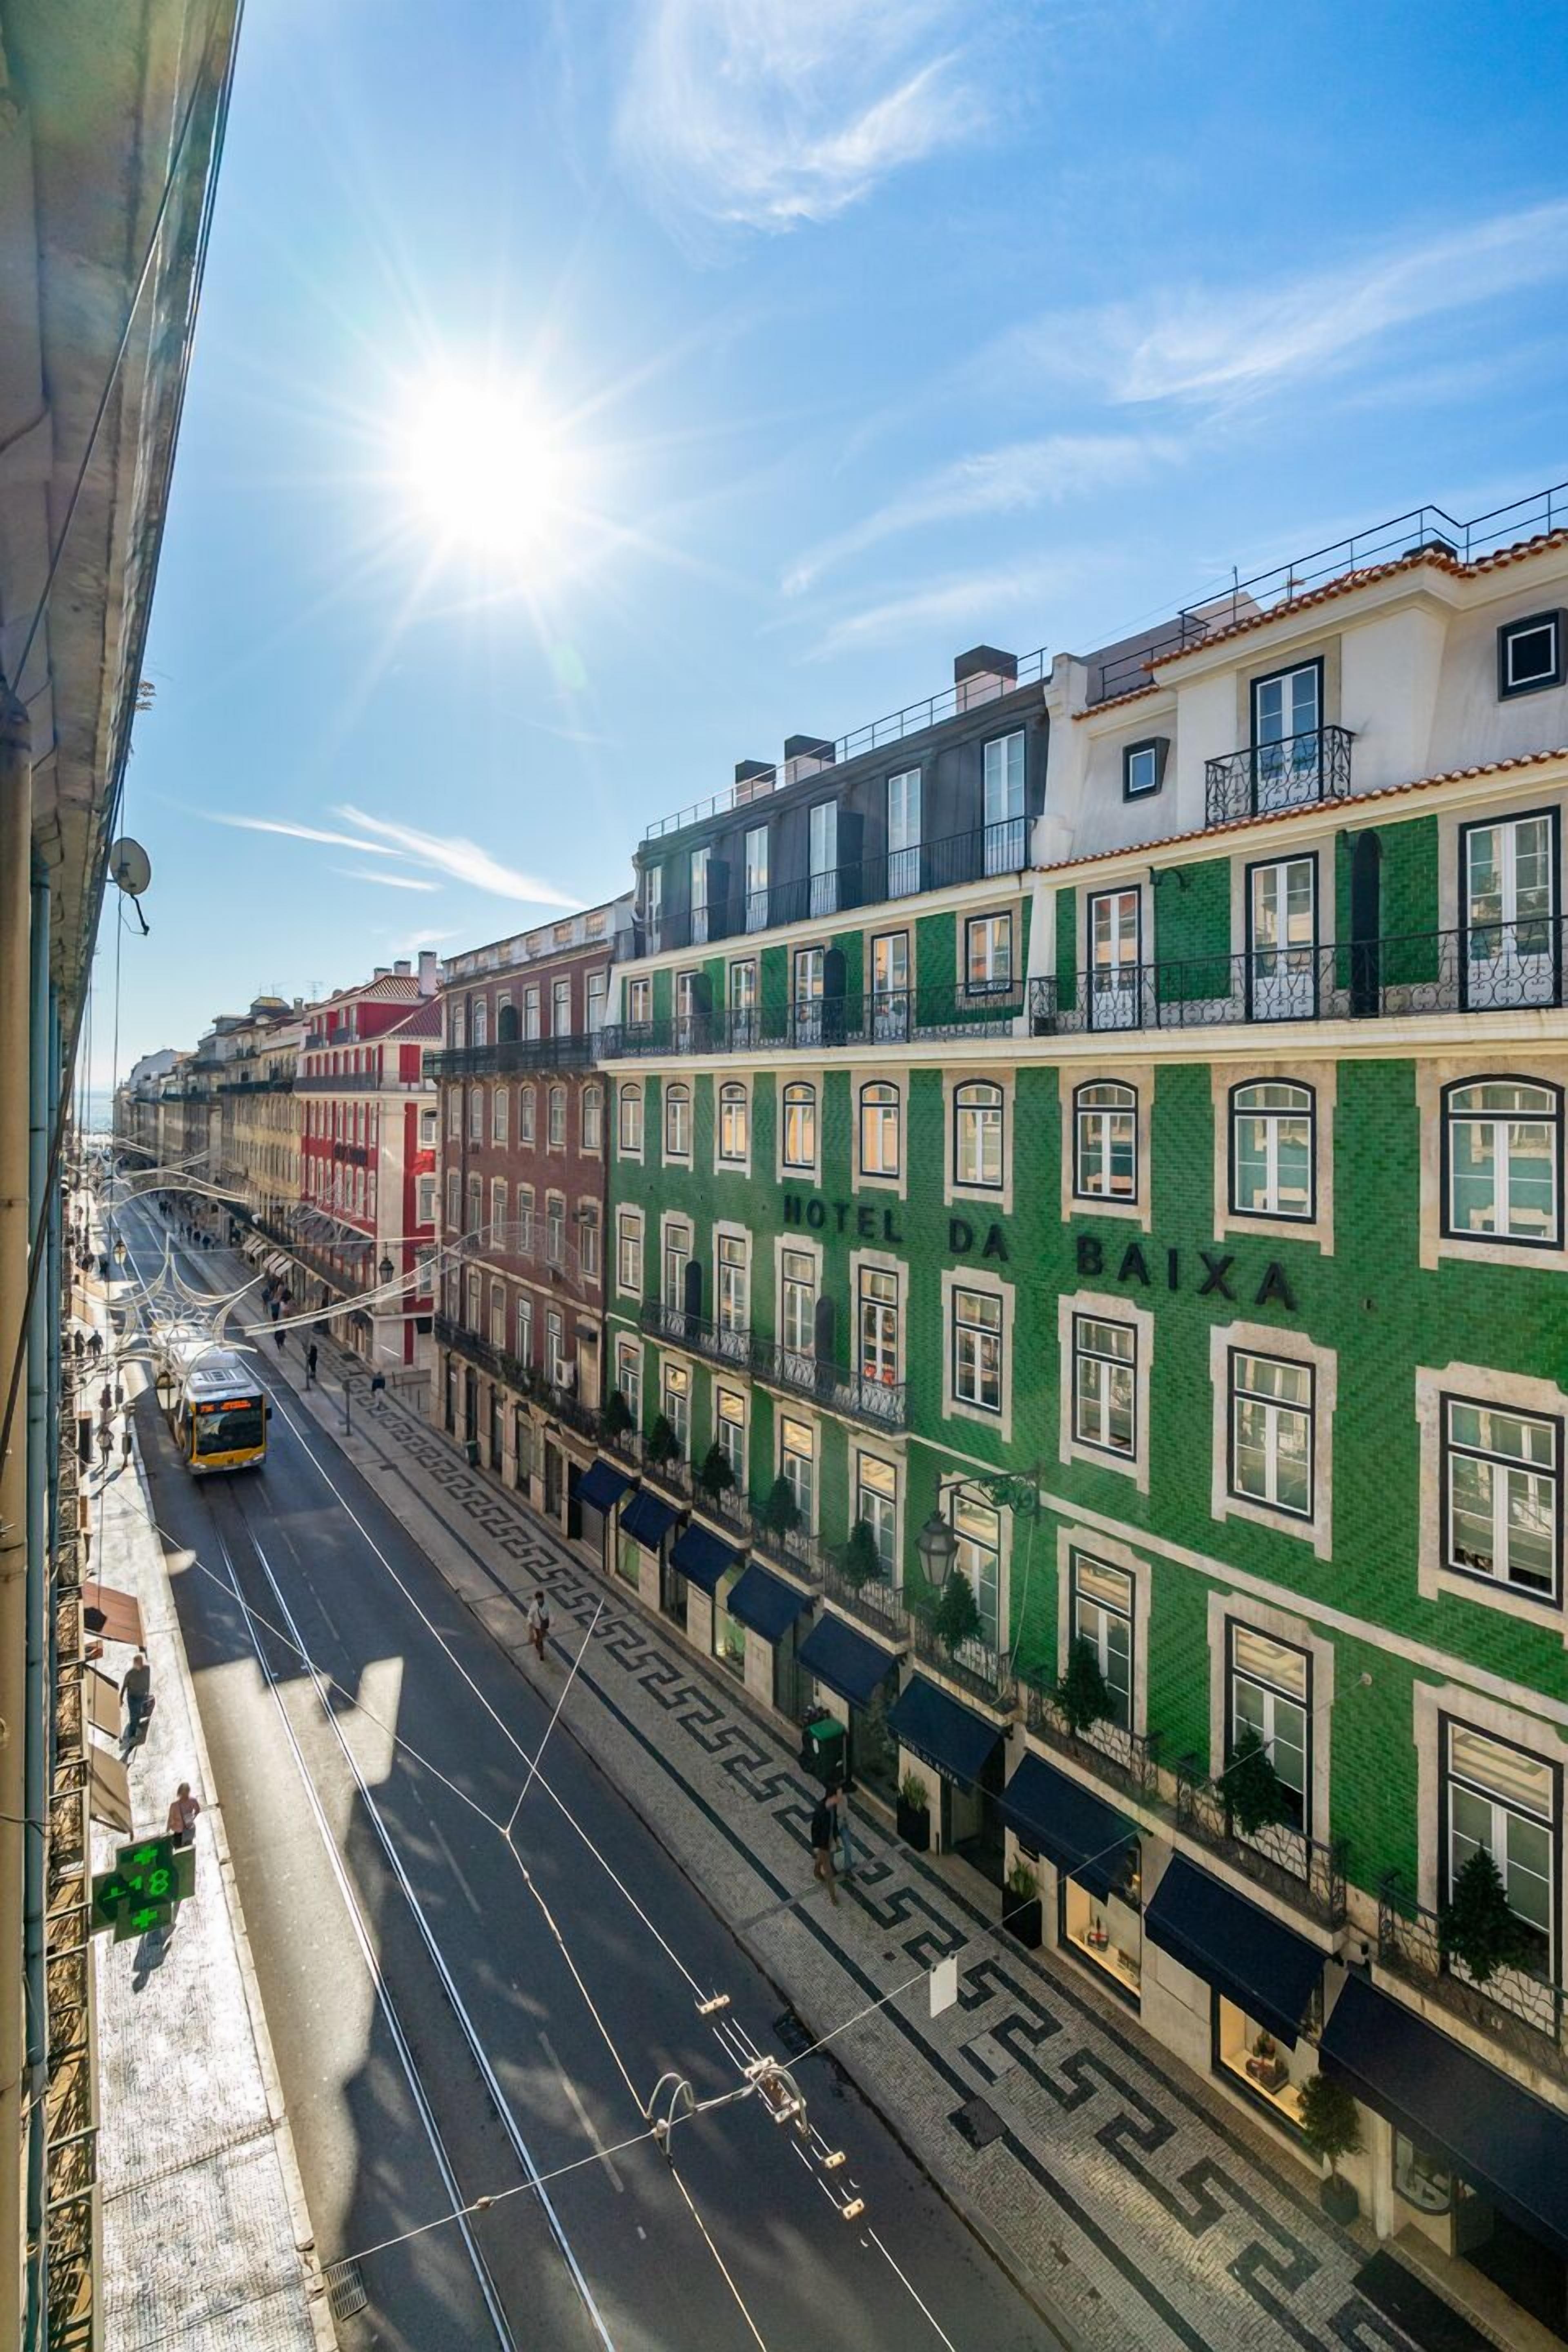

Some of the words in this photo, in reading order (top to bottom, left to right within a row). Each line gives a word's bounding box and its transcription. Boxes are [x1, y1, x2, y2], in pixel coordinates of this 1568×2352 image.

[784, 1195, 903, 1243] HOTEL
[949, 1218, 1009, 1261] DA
[1076, 1236, 1297, 1310] BAIXA
